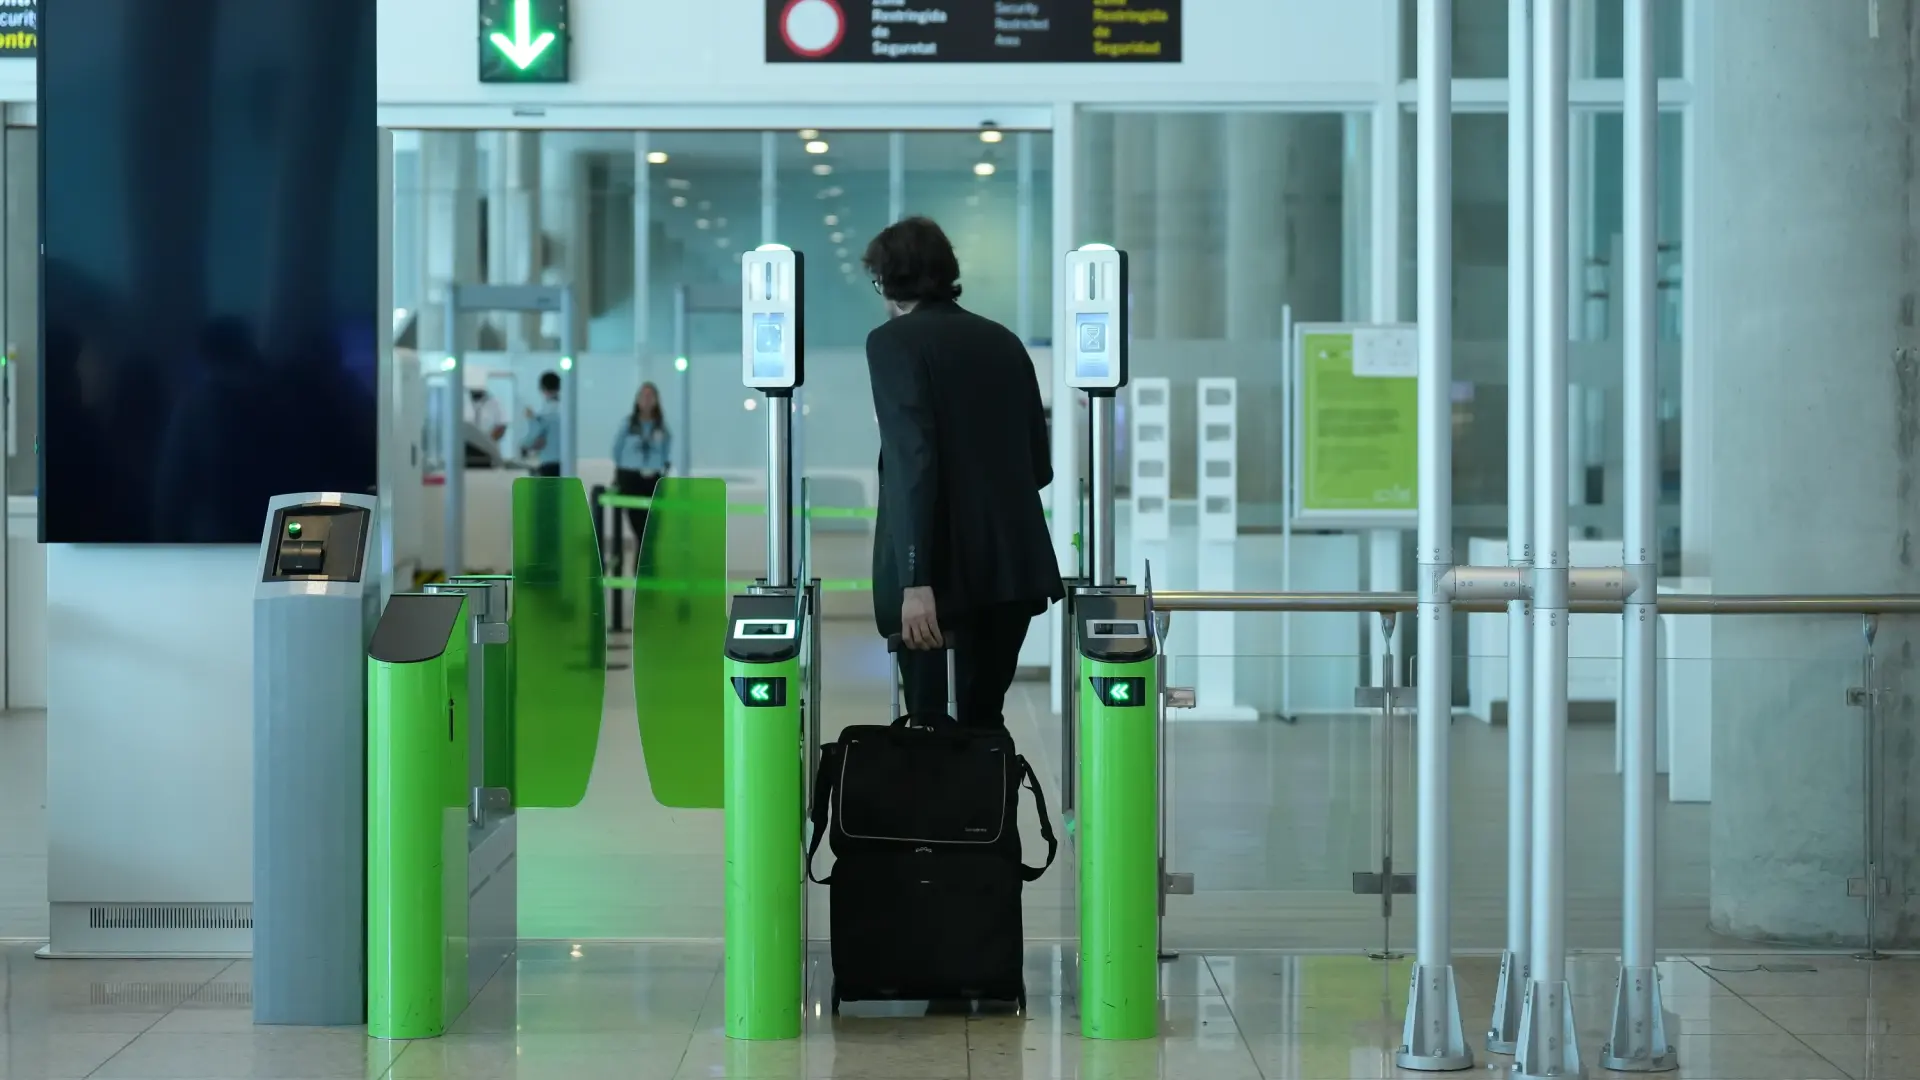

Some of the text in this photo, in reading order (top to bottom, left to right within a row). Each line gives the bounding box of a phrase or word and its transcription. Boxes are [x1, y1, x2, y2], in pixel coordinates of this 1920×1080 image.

[872, 8, 947, 25] Restringida
[1093, 8, 1168, 25] Restringida
[872, 25, 890, 39] de
[1093, 25, 1111, 39] de
